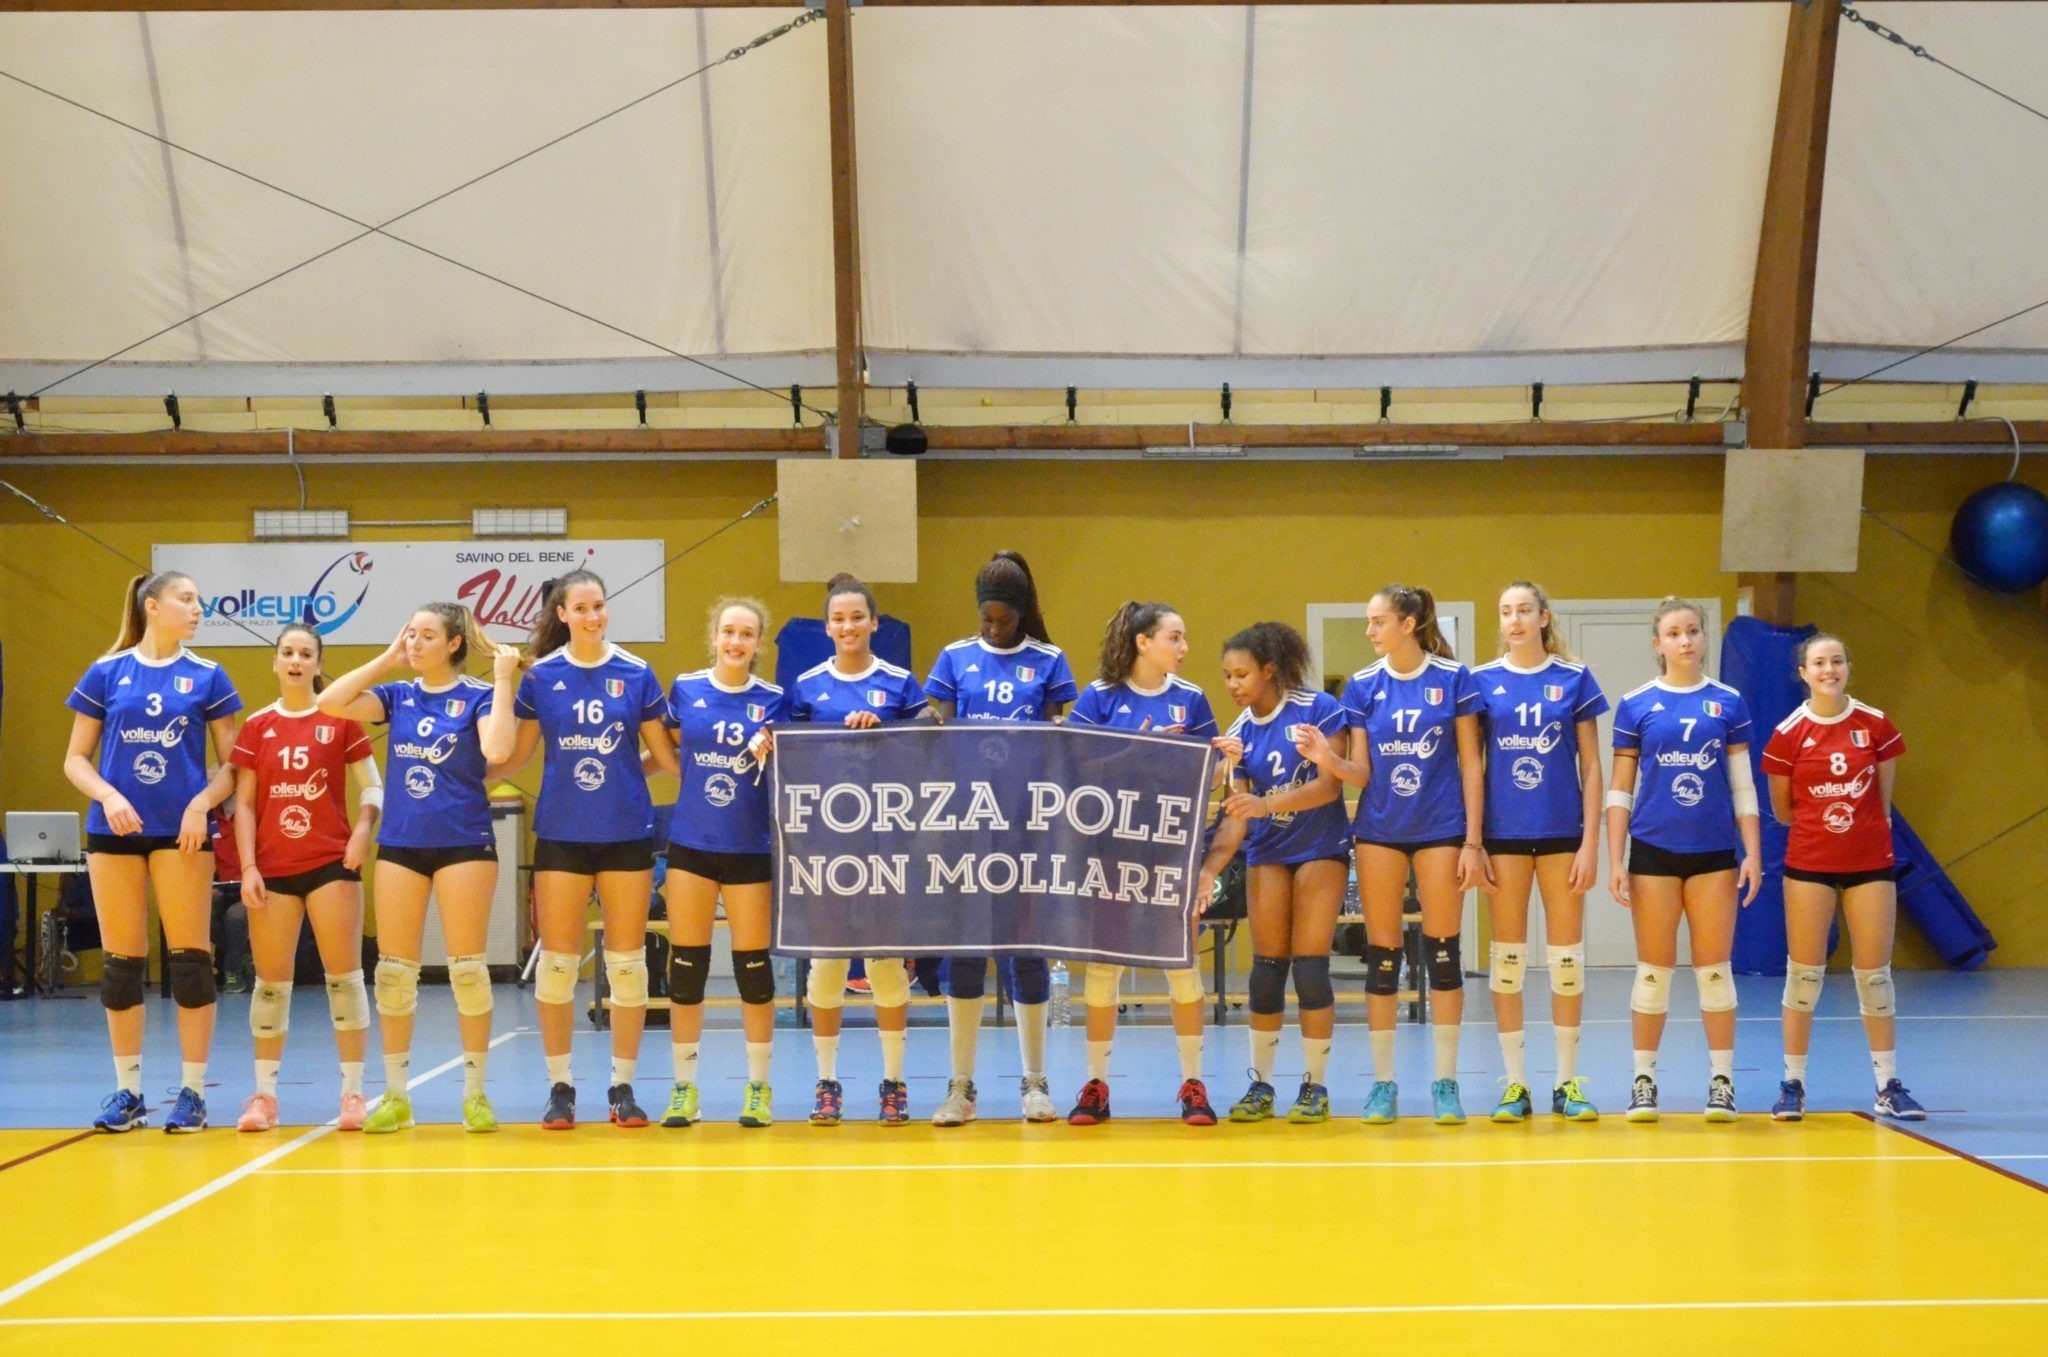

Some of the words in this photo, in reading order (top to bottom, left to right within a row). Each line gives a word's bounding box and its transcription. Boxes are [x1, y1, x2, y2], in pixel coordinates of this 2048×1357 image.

[456, 552, 504, 563] SAVINO
[509, 552, 534, 563] DEL
[539, 552, 575, 563] BENE
[984, 680, 1014, 704] 18
[145, 693, 163, 717] 3
[572, 699, 604, 724] 16
[1514, 702, 1542, 727] 11
[417, 716, 436, 737] 6
[712, 720, 744, 746] 13
[1391, 709, 1422, 733] 17
[1680, 718, 1697, 742] 7
[277, 746, 309, 770] 15
[1267, 750, 1286, 777] 2
[1829, 752, 1848, 776] 8
[784, 781, 1009, 833] FORZA
[1026, 781, 1191, 845] POLE
[788, 854, 909, 896] NON
[925, 852, 1182, 906] MOLLARE
